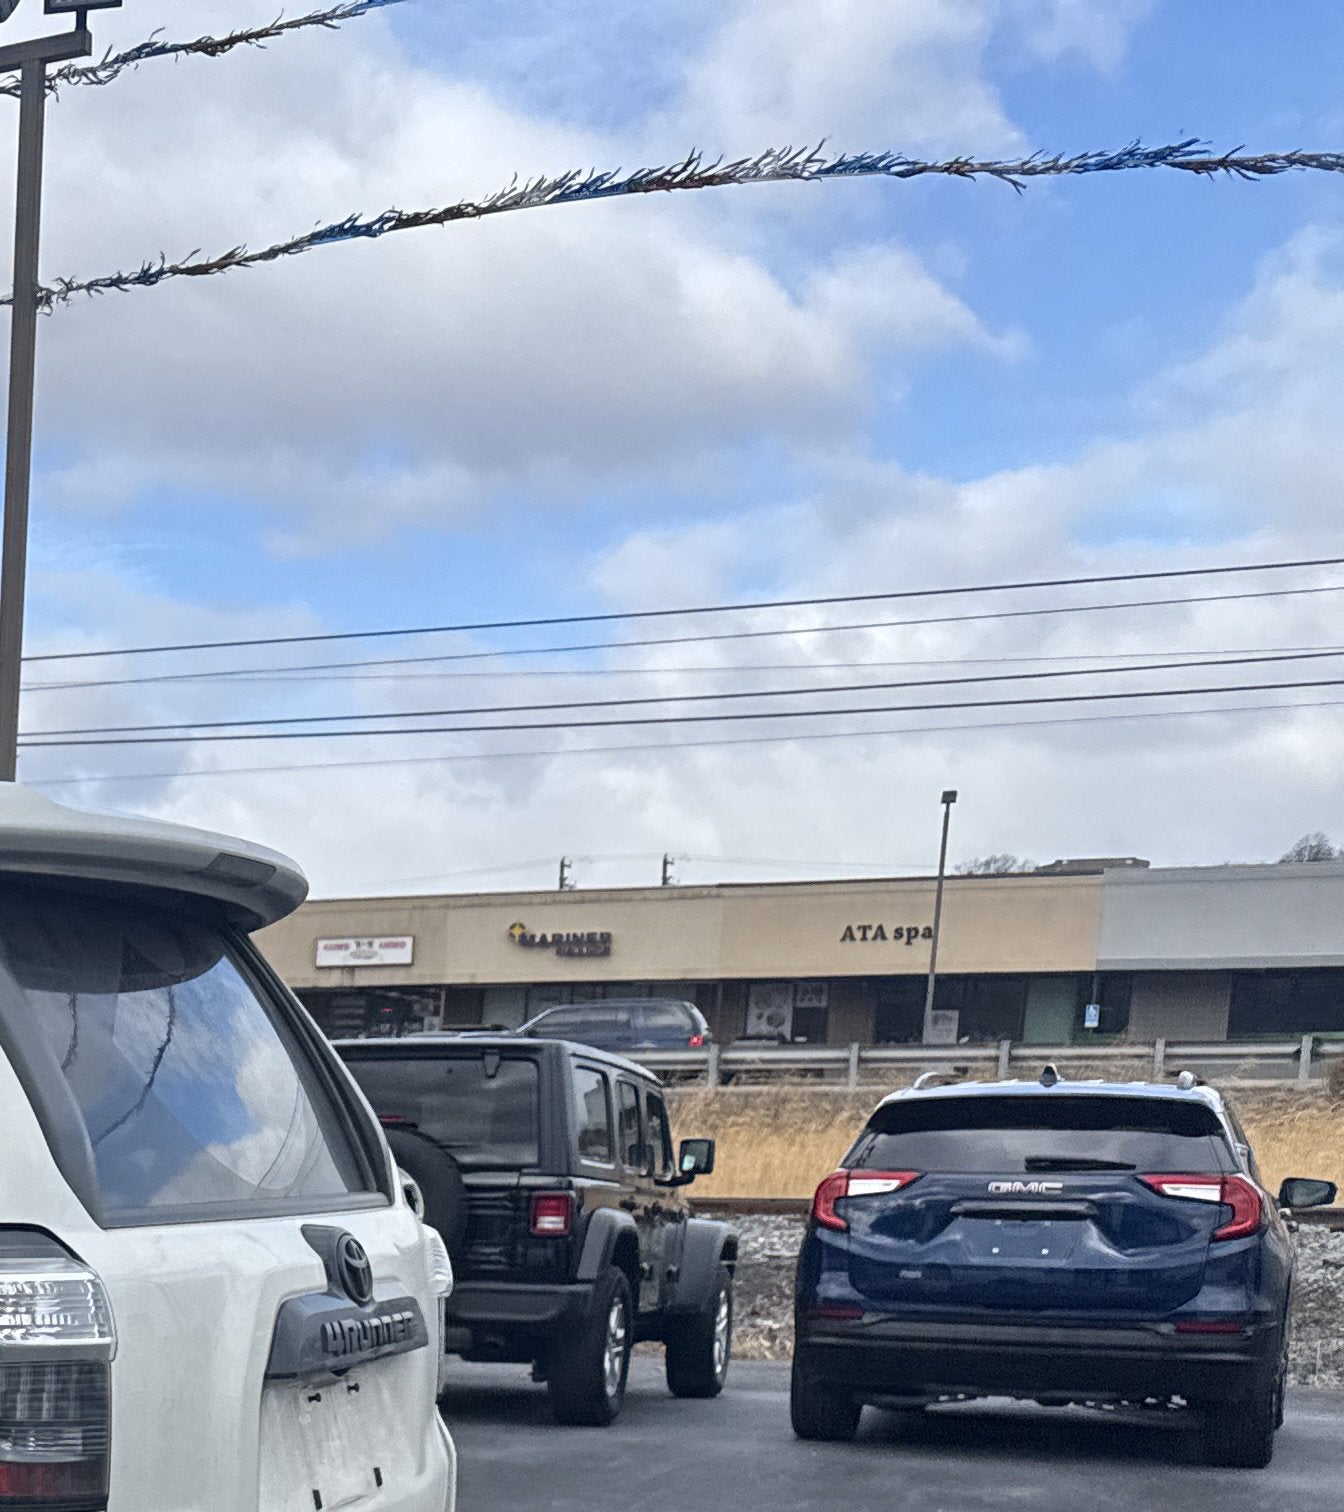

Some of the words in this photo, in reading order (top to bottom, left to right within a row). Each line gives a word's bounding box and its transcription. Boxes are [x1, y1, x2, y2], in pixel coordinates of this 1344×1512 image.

[840, 924, 887, 942] ATA
[893, 925, 934, 946] spa
[987, 1181, 1064, 1195] GMC
